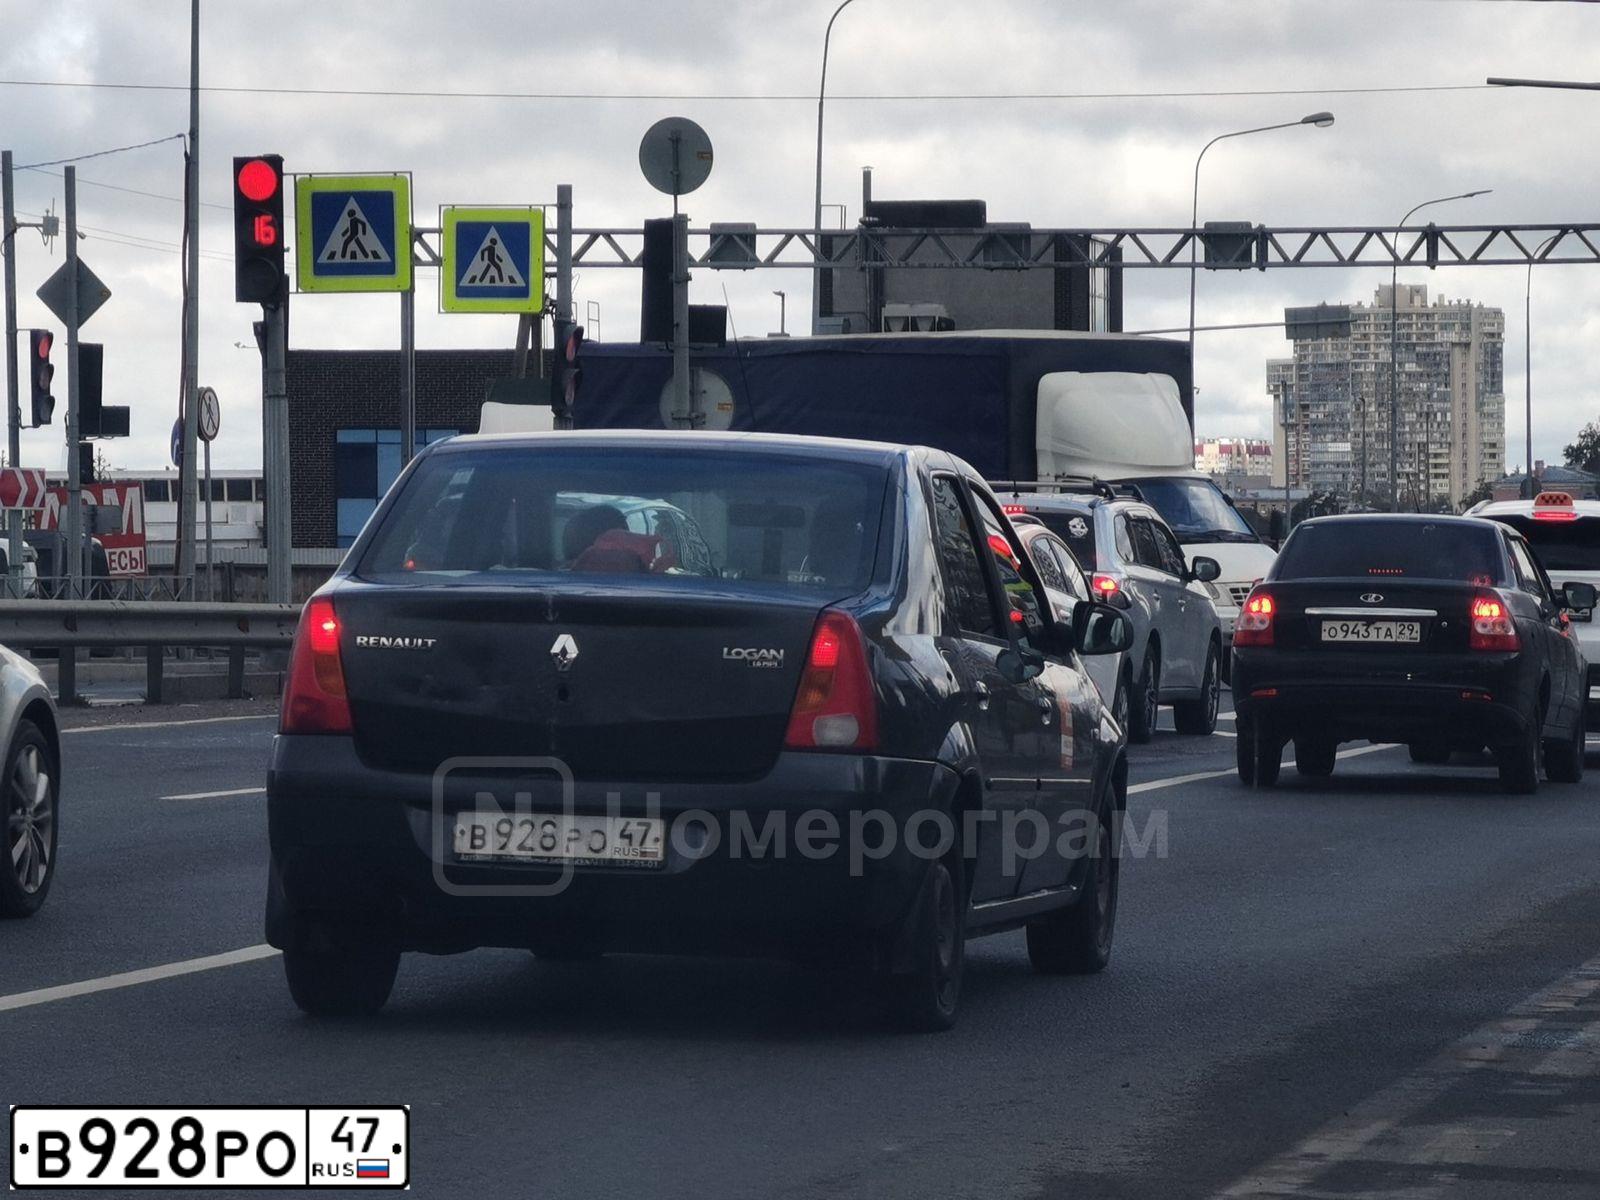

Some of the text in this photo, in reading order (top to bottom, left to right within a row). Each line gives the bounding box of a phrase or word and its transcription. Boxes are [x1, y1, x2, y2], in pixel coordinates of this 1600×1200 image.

[254, 214, 276, 246] 16
[1327, 622, 1415, 640] О943ТА 29
[356, 635, 437, 649] RENAULT
[722, 647, 785, 660] LOGAN
[469, 817, 653, 854] В928РО 47
[612, 846, 640, 858] RUS
